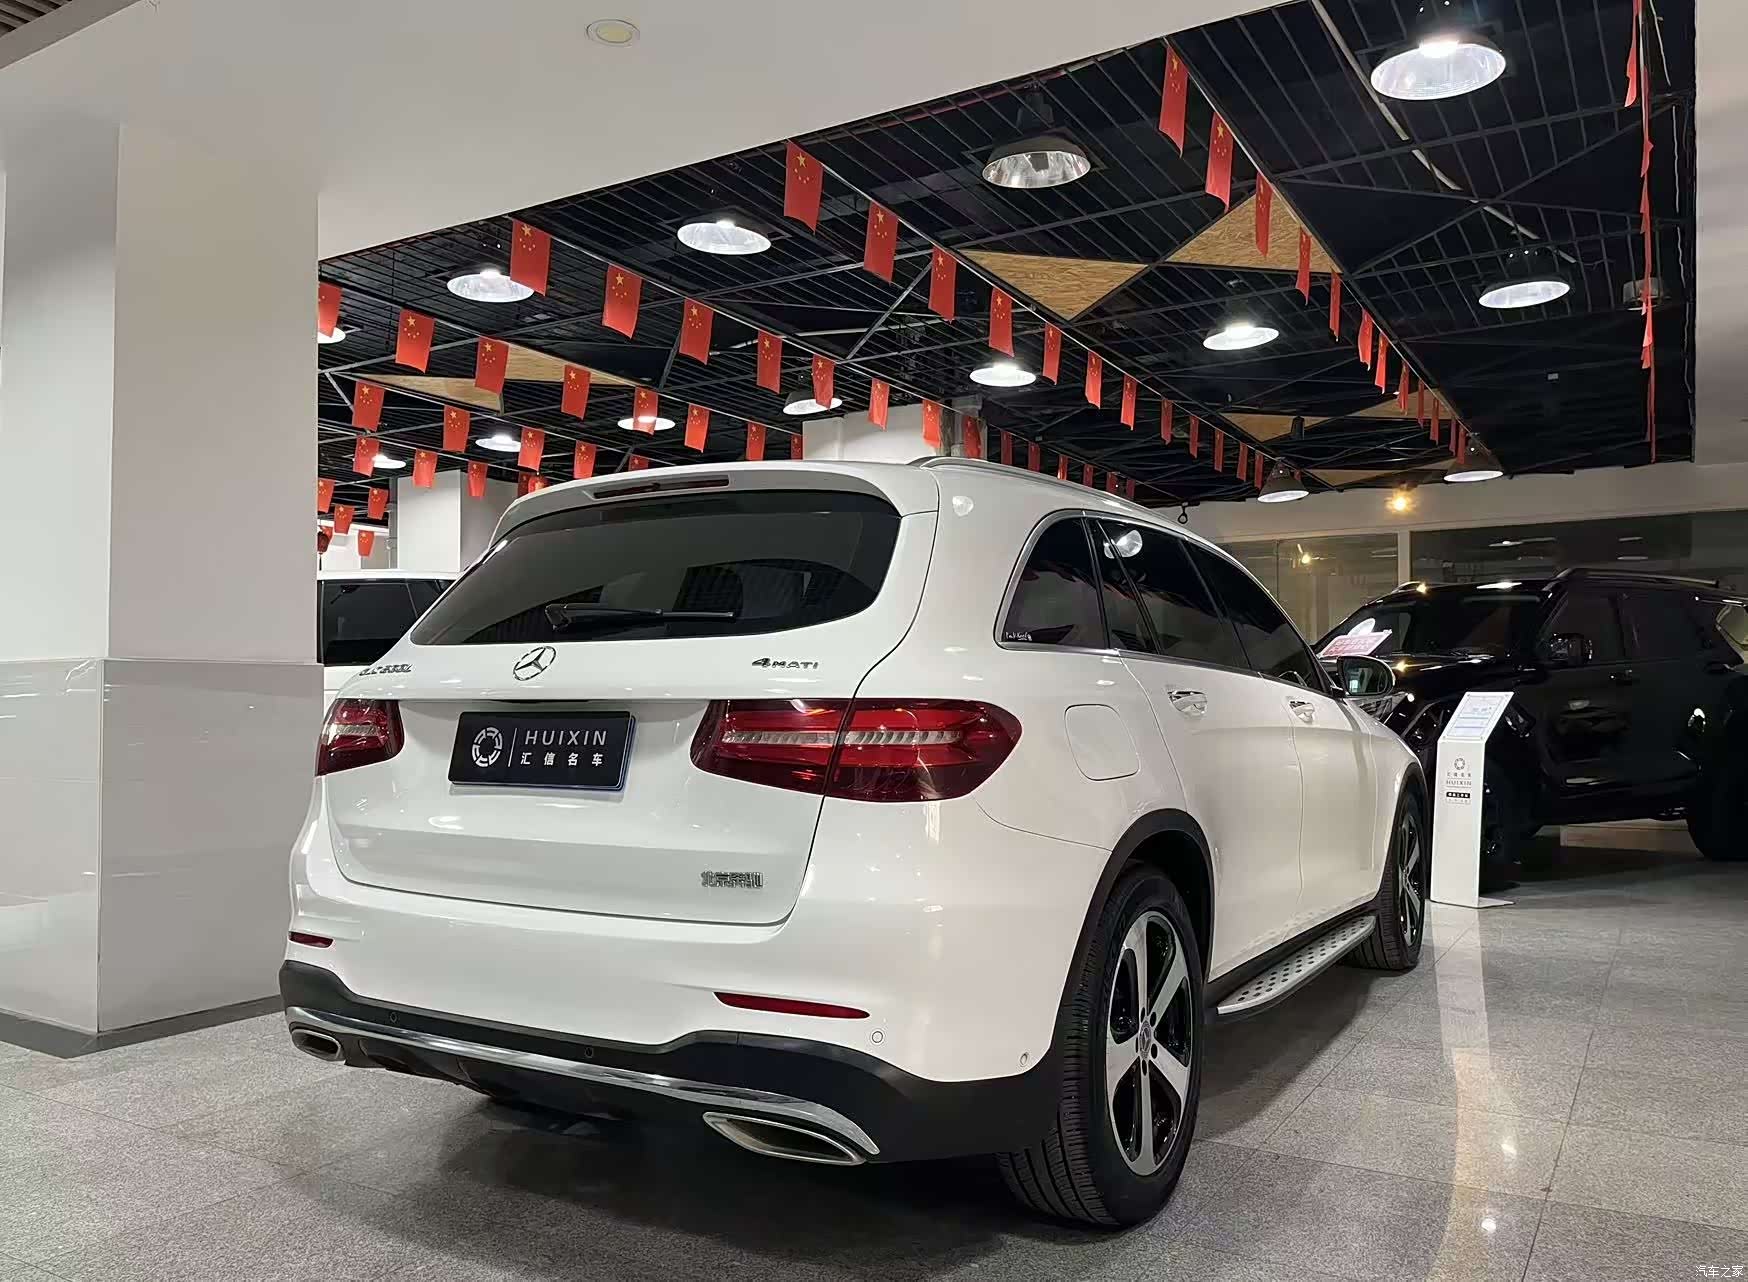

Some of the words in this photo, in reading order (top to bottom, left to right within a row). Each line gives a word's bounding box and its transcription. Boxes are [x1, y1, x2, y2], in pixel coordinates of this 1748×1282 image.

[524, 730, 607, 746] HUIXIN
[520, 751, 604, 767] 汇信名车
